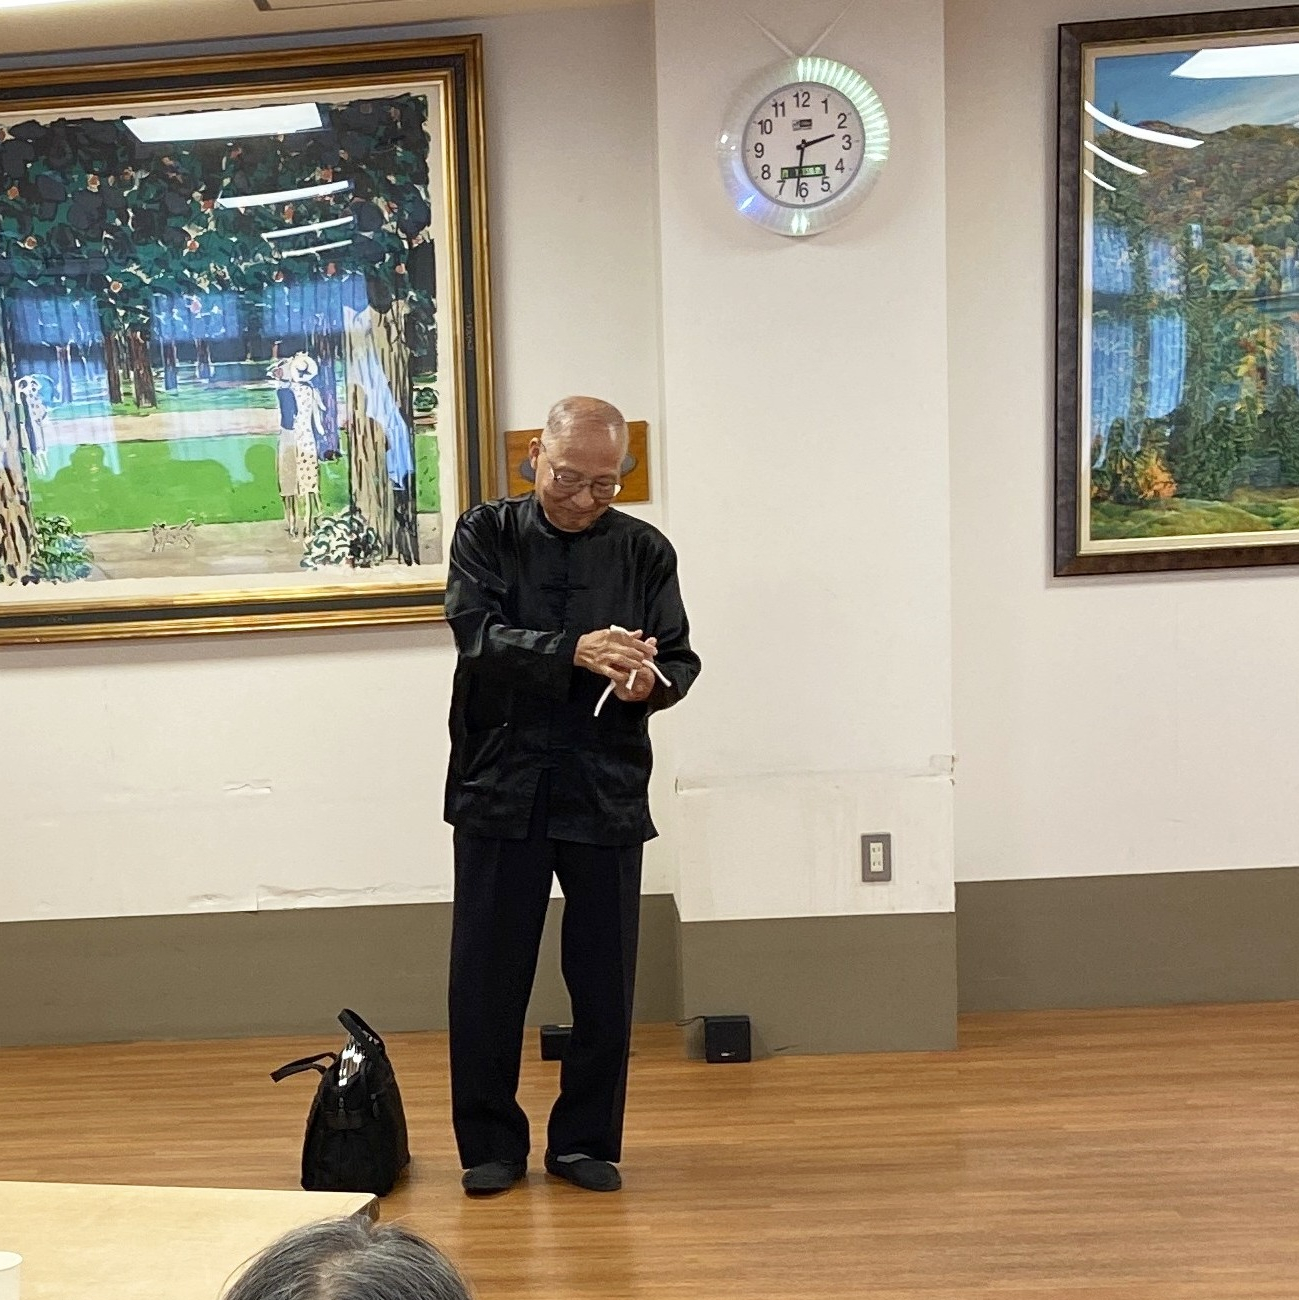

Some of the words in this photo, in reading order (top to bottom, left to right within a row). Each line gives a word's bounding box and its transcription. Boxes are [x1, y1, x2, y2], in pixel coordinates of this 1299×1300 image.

[793, 91, 810, 108] 12
[821, 98, 829, 114] 1
[772, 101, 786, 117] 11
[757, 118, 773, 135] 10
[837, 112, 847, 129] 2
[754, 142, 764, 158] 9
[841, 134, 852, 151] 3
[761, 164, 771, 180] 8
[835, 158, 845, 173] 4
[776, 179, 786, 196] 7
[799, 182, 809, 198] 6
[821, 176, 831, 192] 5
